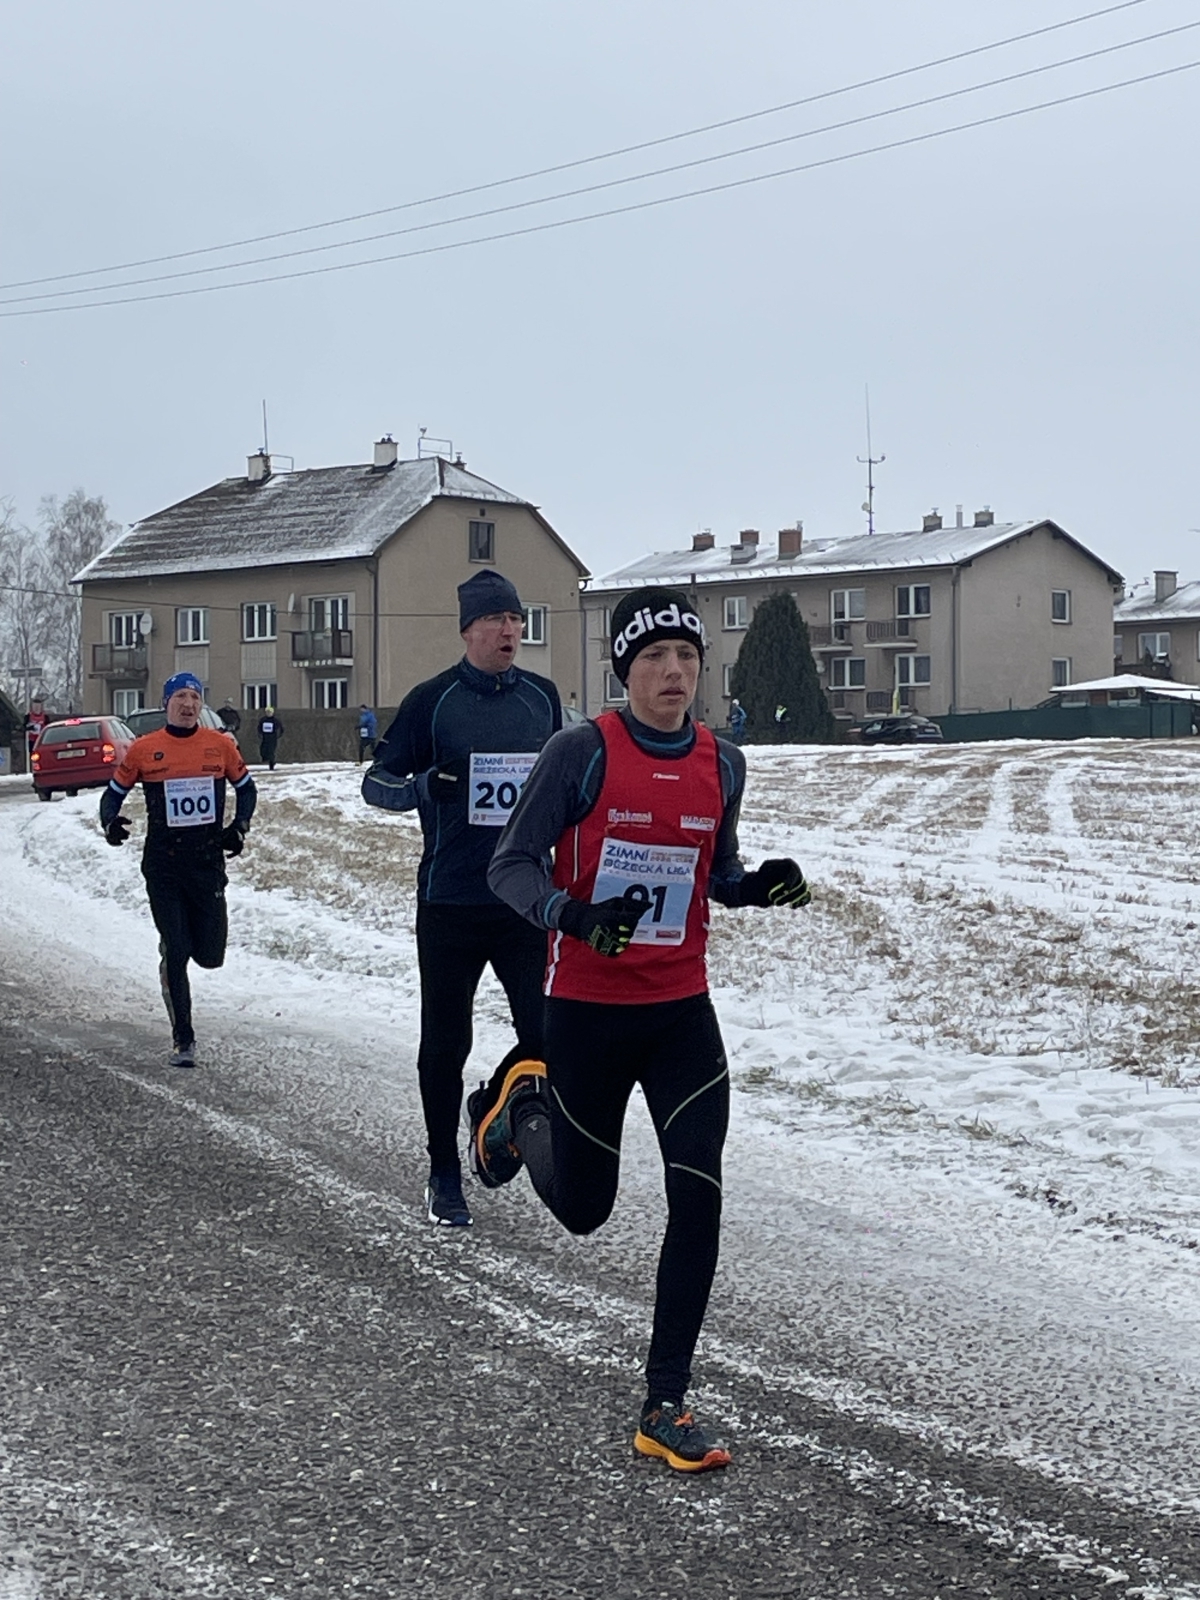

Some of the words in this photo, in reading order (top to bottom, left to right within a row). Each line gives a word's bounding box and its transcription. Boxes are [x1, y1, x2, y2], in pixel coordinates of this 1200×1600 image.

[169, 795, 211, 817] 100
[605, 844, 650, 862] ZIMNÍ
[666, 864, 692, 876] LIGA
